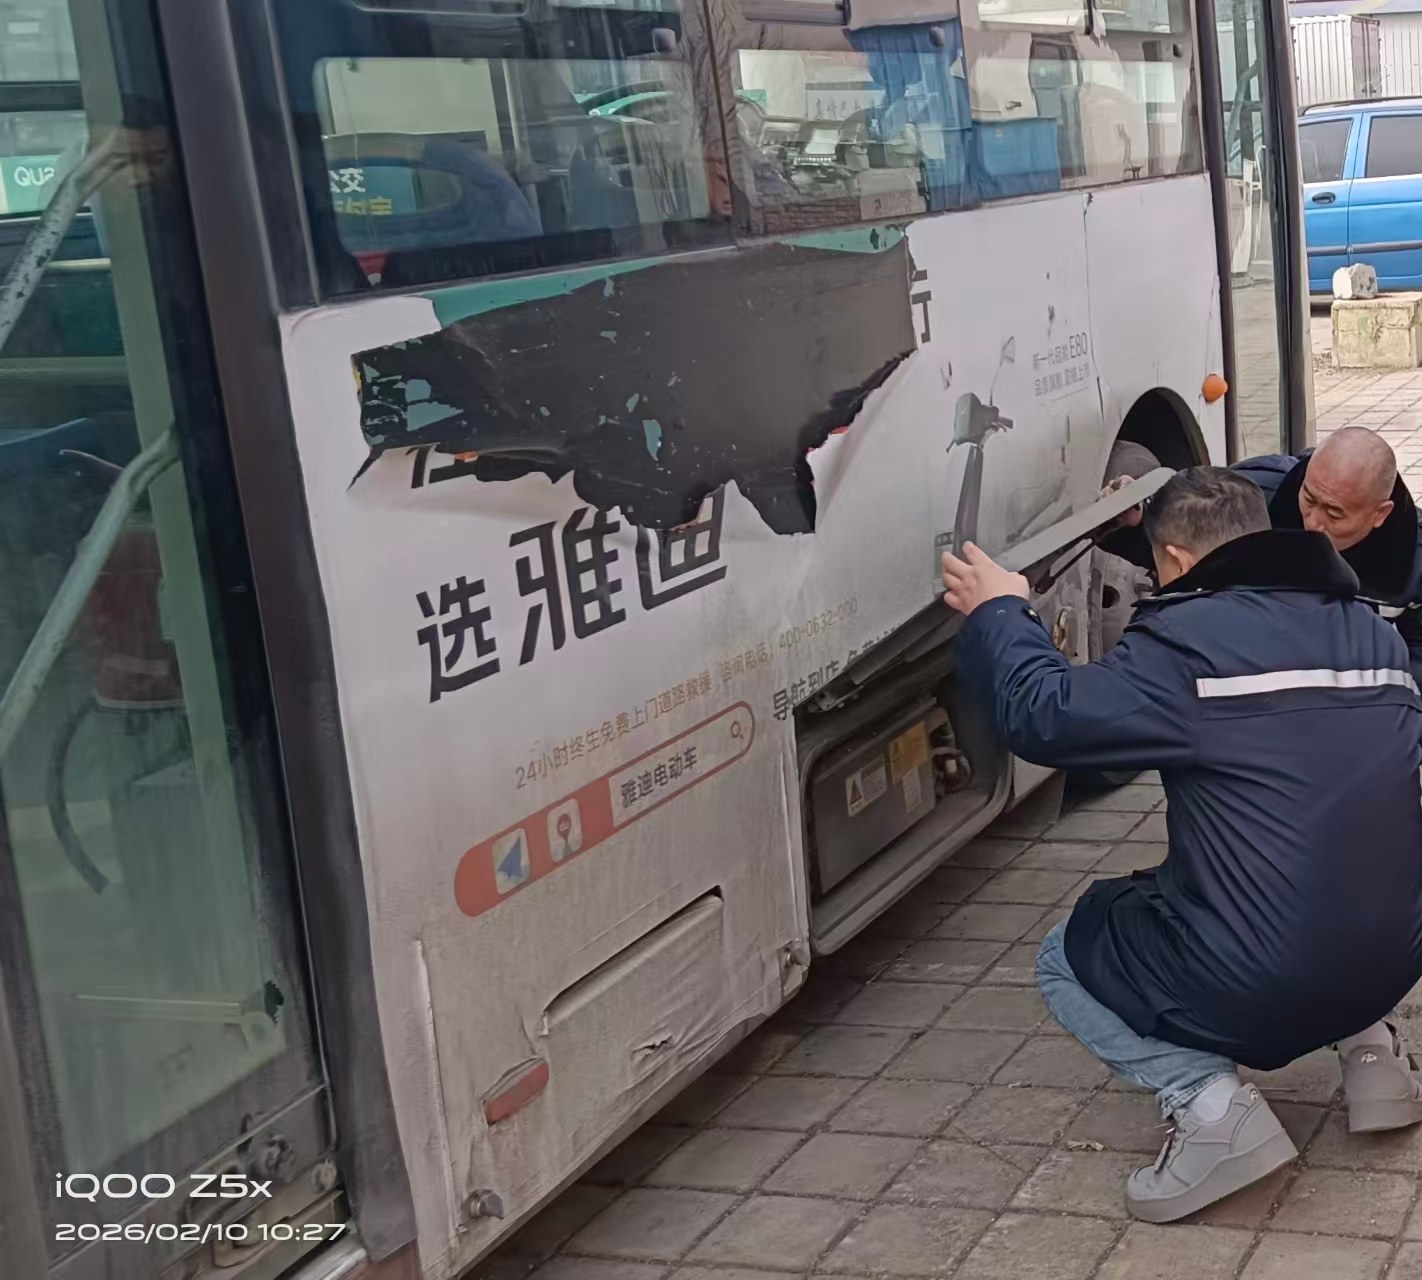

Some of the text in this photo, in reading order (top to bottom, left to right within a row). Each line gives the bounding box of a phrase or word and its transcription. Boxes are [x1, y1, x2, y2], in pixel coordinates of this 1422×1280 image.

[620, 746, 698, 808] 雅迪电动车
